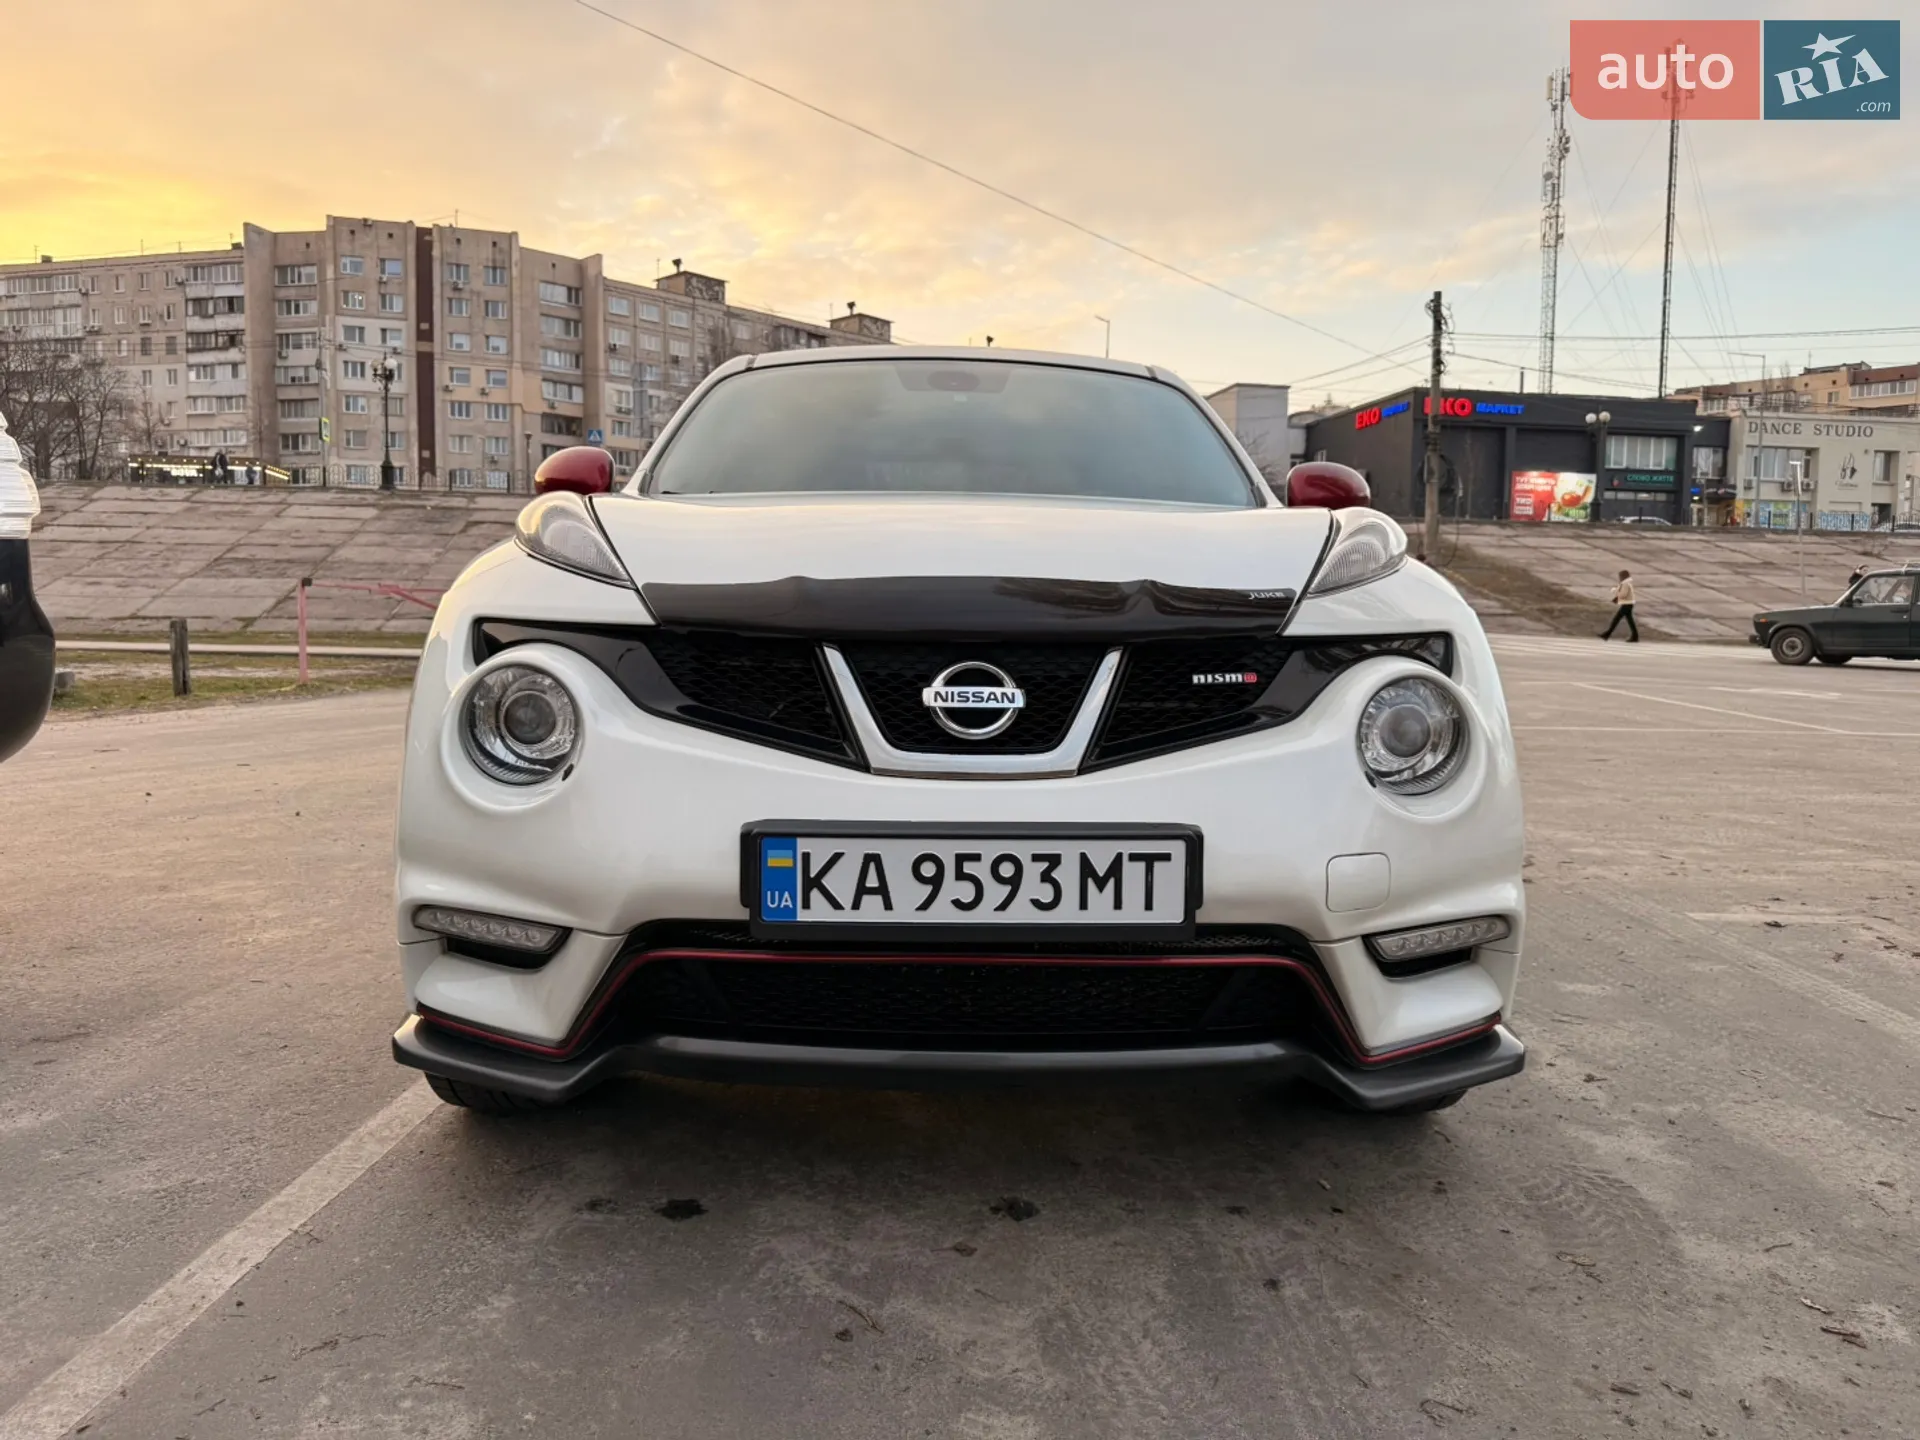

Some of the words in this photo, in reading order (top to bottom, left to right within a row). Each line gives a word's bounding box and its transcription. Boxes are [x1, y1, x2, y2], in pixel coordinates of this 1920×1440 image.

[1748, 421, 1802, 435] DANCE
[1813, 424, 1874, 438] STUDIO
[933, 691, 1016, 704] NISSAN
[801, 852, 894, 911] KA
[911, 852, 1063, 911] 9593
[1079, 852, 1172, 911] MT
[767, 890, 793, 909] UA
